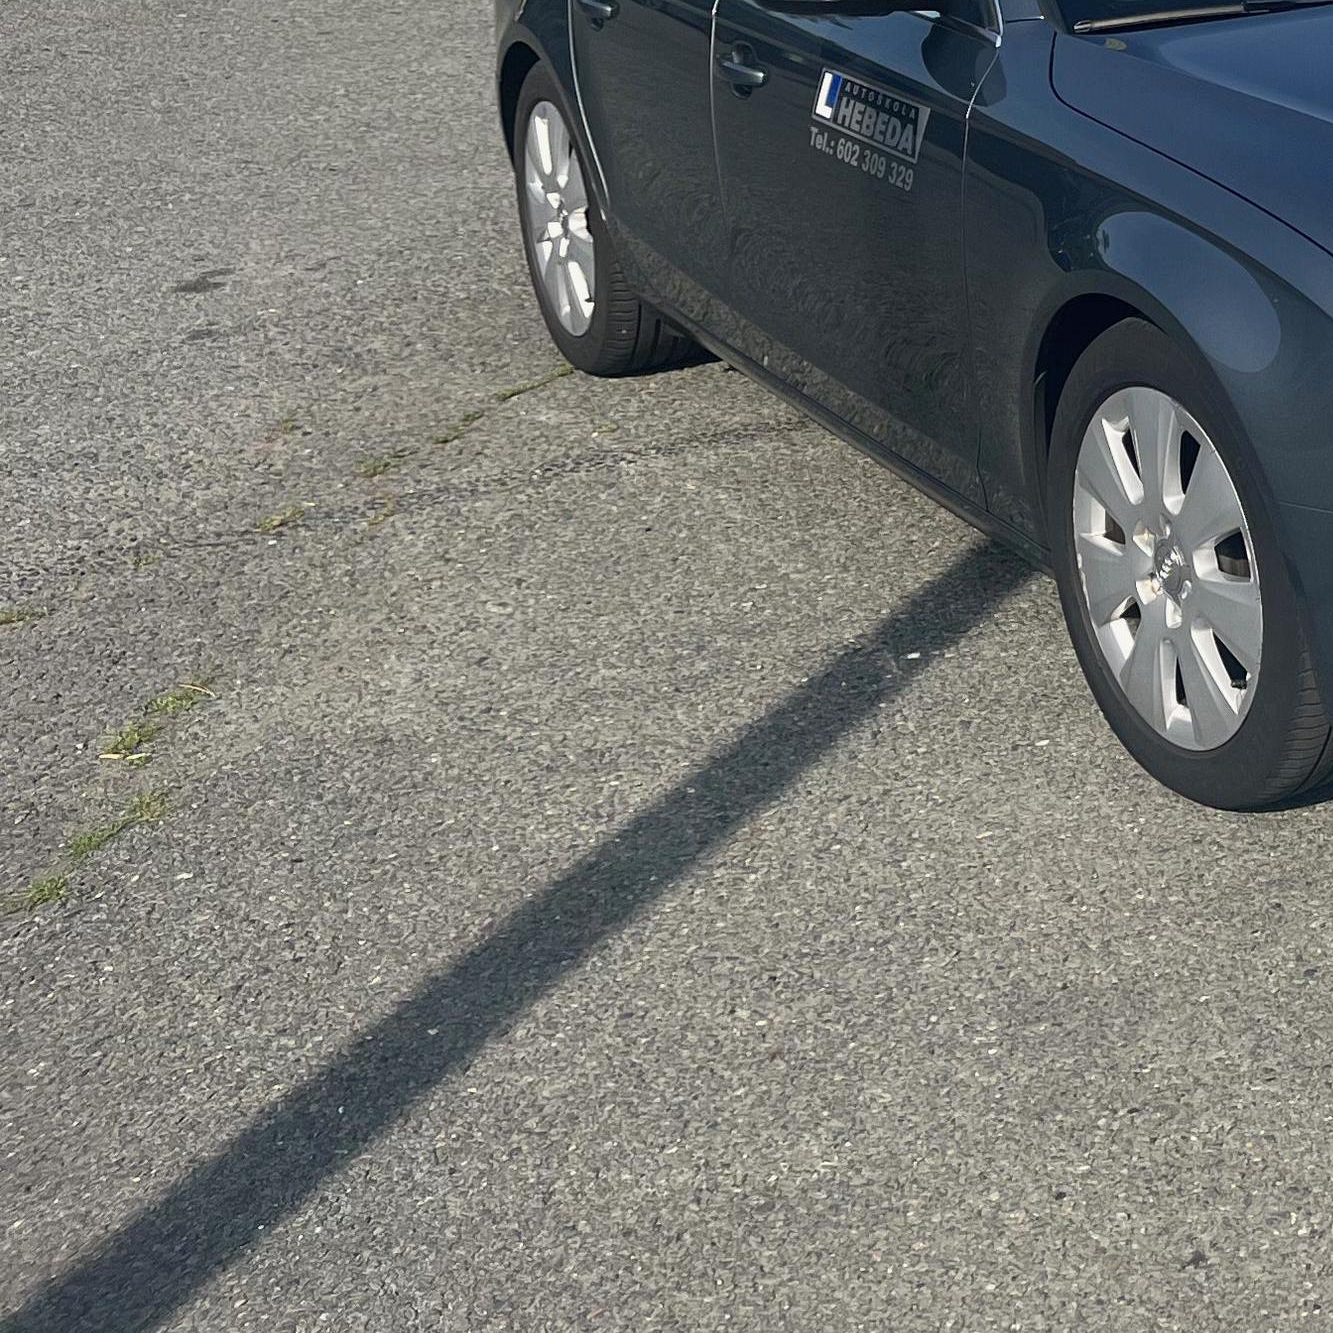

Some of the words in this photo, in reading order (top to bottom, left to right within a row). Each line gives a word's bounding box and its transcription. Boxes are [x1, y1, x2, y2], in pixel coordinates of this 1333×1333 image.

[837, 96, 915, 155] HEBEDA
[809, 126, 835, 155] Tel.:
[836, 137, 860, 167] 602
[862, 149, 887, 179] 309
[888, 161, 914, 192] 329
